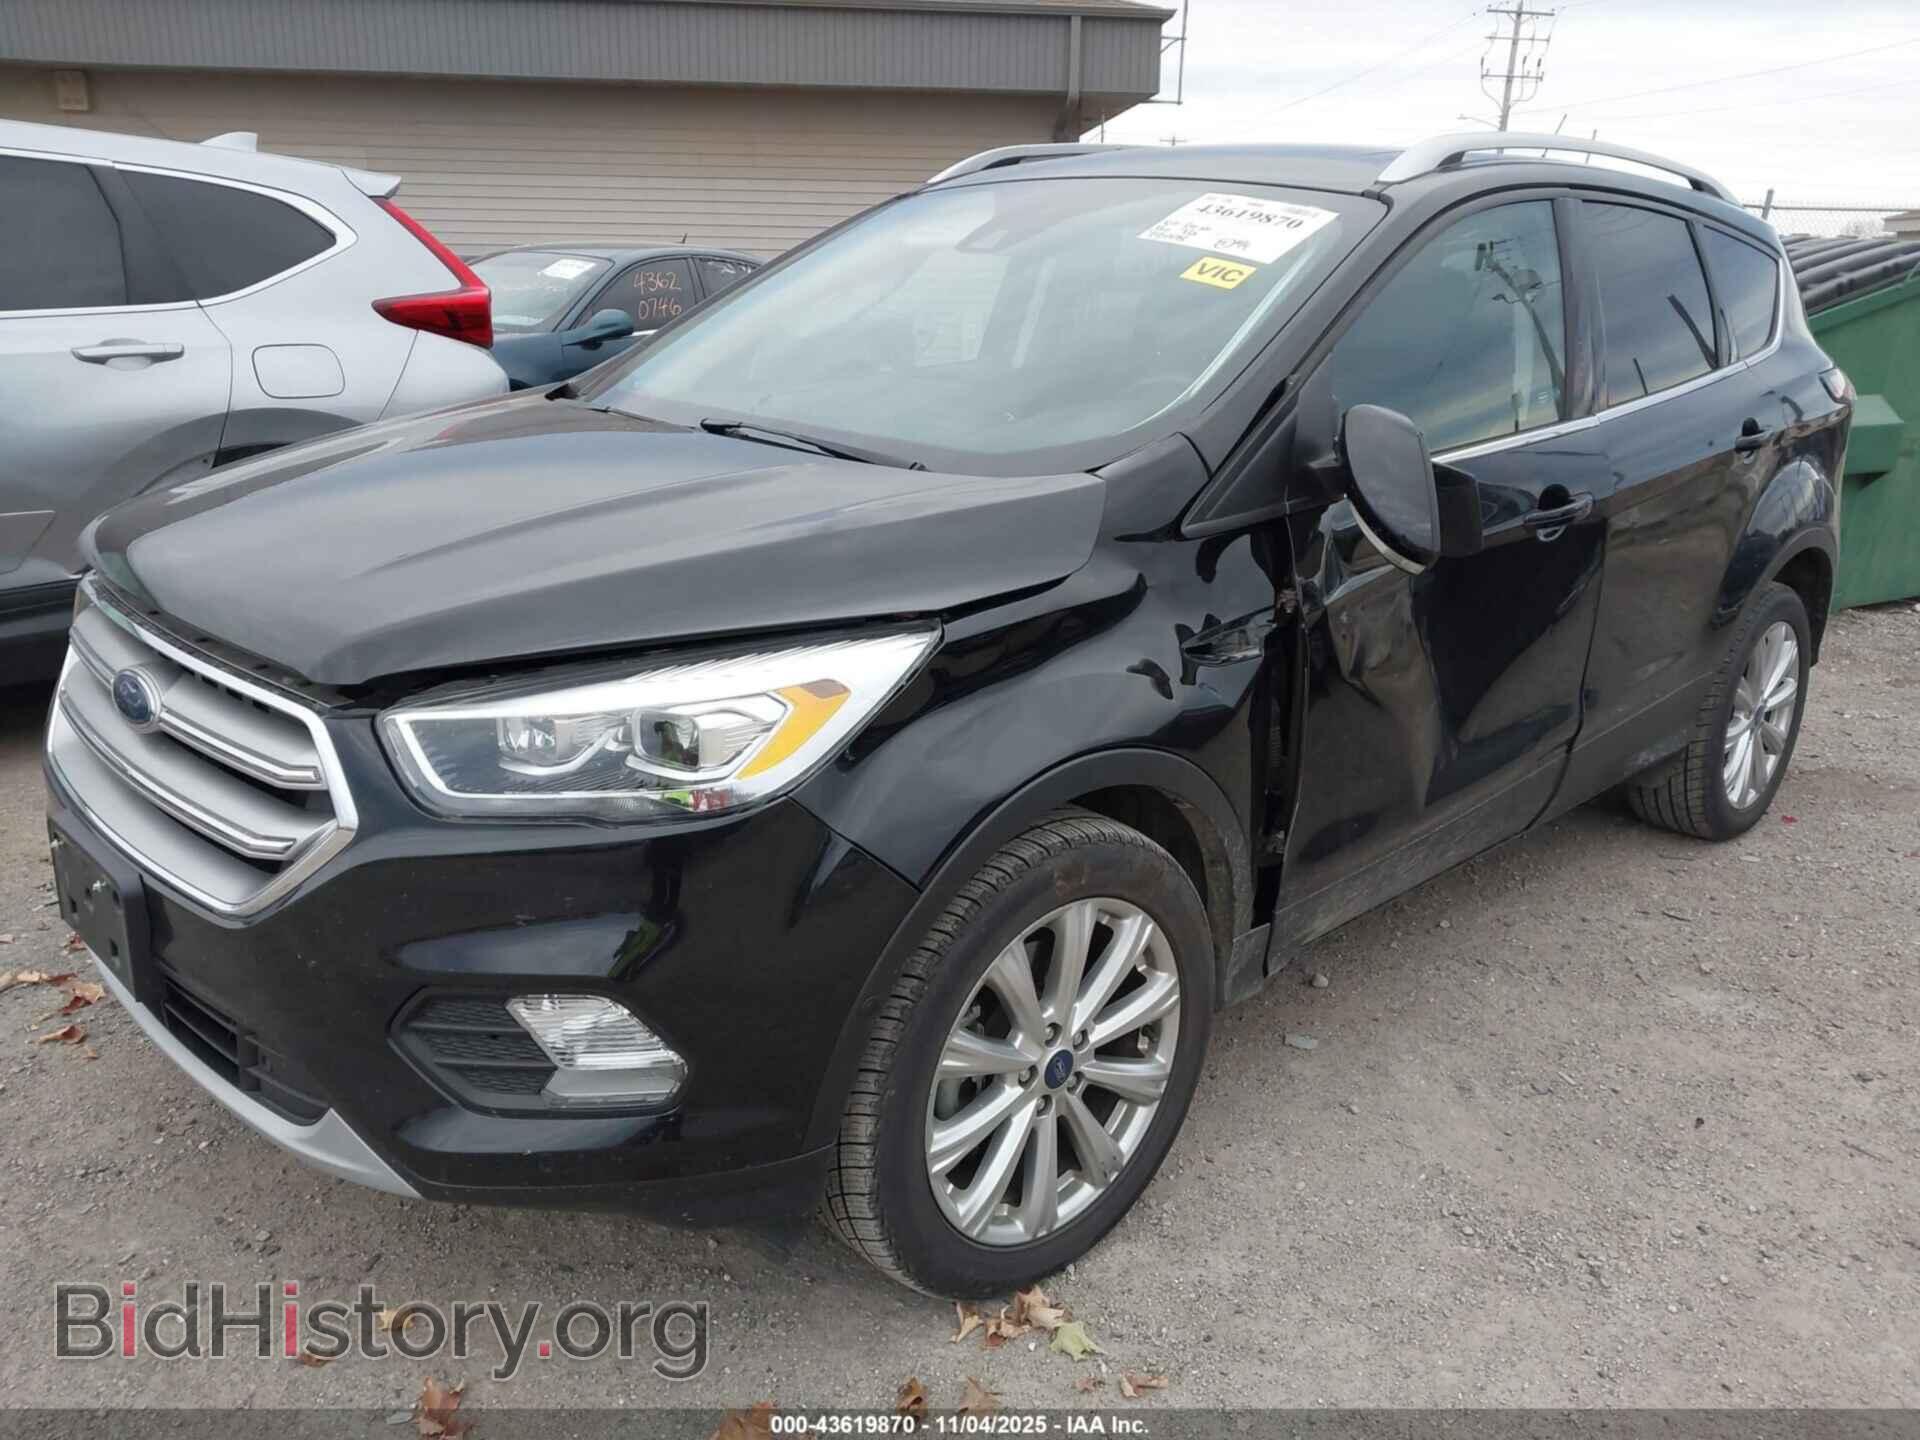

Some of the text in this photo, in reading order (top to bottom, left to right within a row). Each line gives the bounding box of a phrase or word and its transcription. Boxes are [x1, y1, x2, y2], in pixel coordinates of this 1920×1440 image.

[633, 271, 681, 295] 4362
[1197, 262, 1244, 282] VIC
[638, 297, 682, 320] 0746
